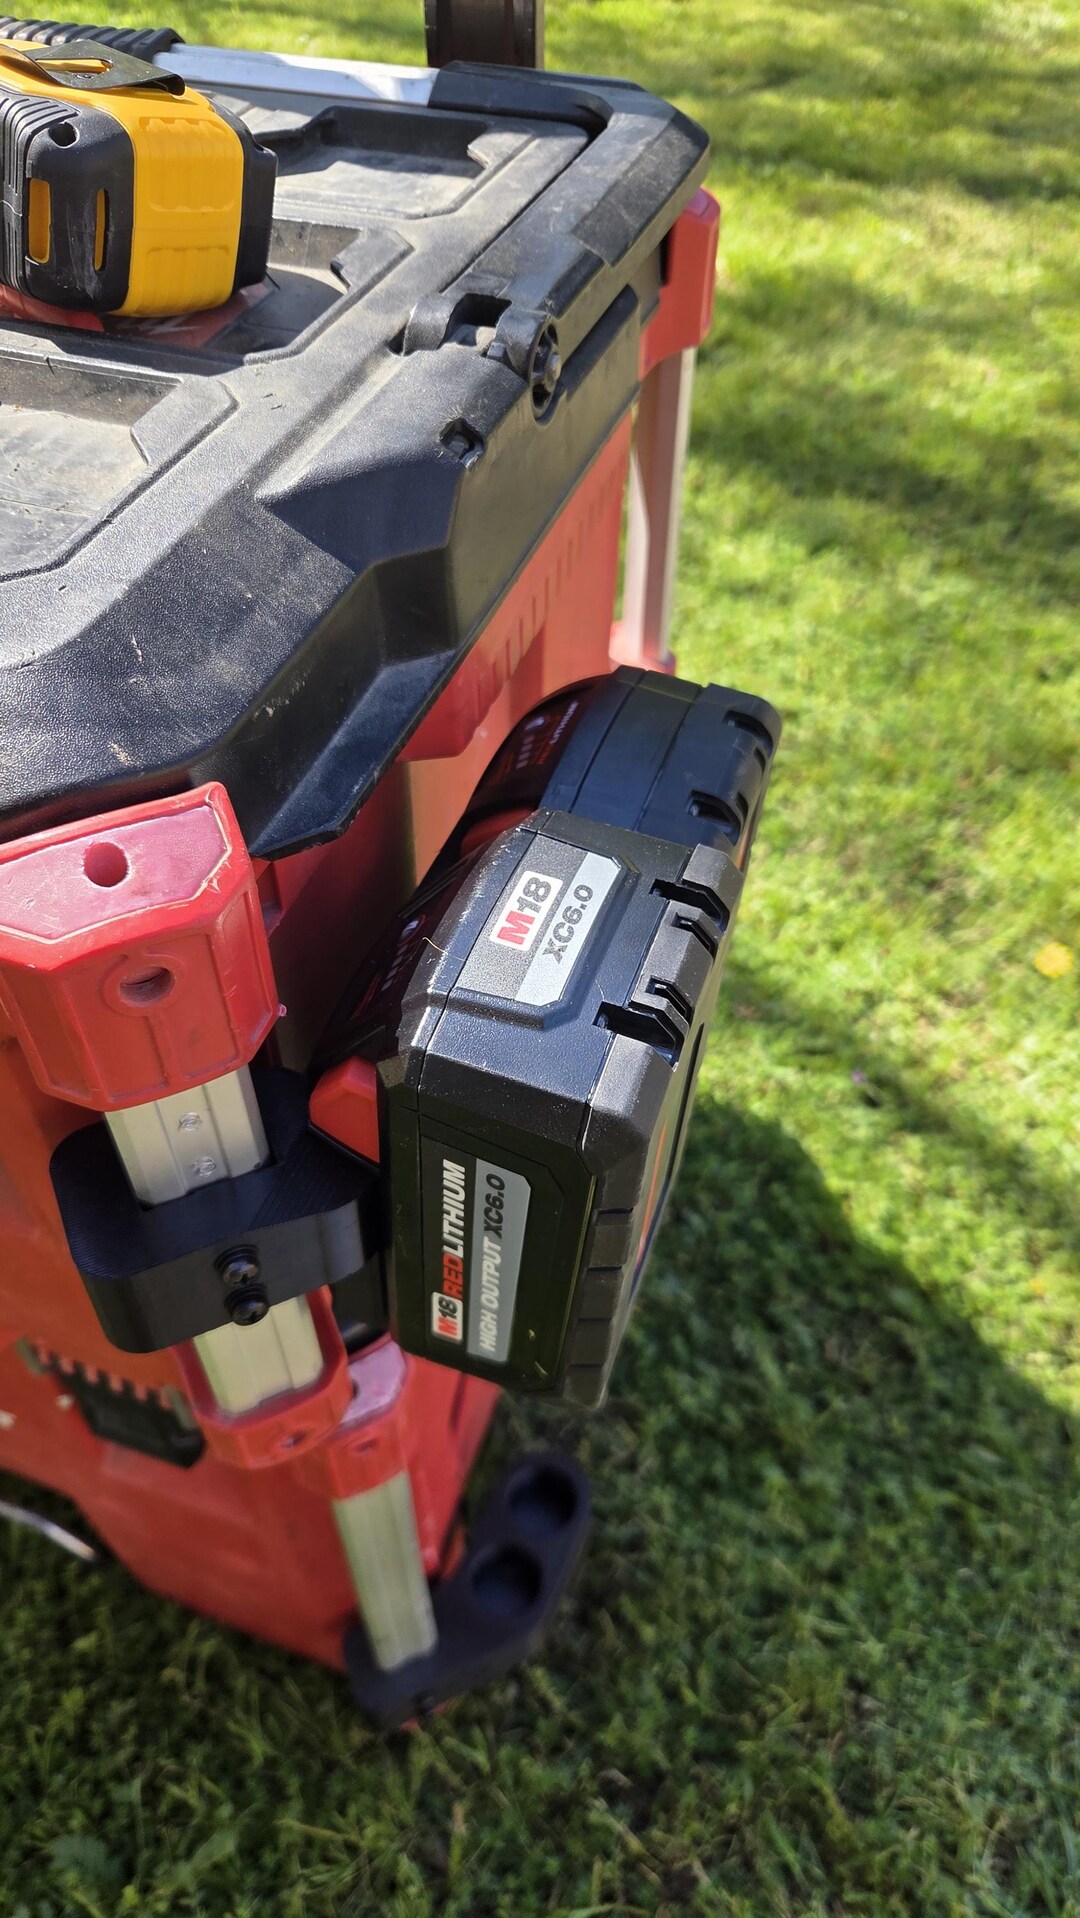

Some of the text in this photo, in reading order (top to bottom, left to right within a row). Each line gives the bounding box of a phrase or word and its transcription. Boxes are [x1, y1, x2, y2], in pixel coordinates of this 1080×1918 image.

[496, 876, 552, 946] M18
[541, 884, 594, 965] XC6.0
[437, 1158, 466, 1337] M18 REDLITHIUM
[479, 1173, 506, 1352] HIGH OUTPUT XC6.0
